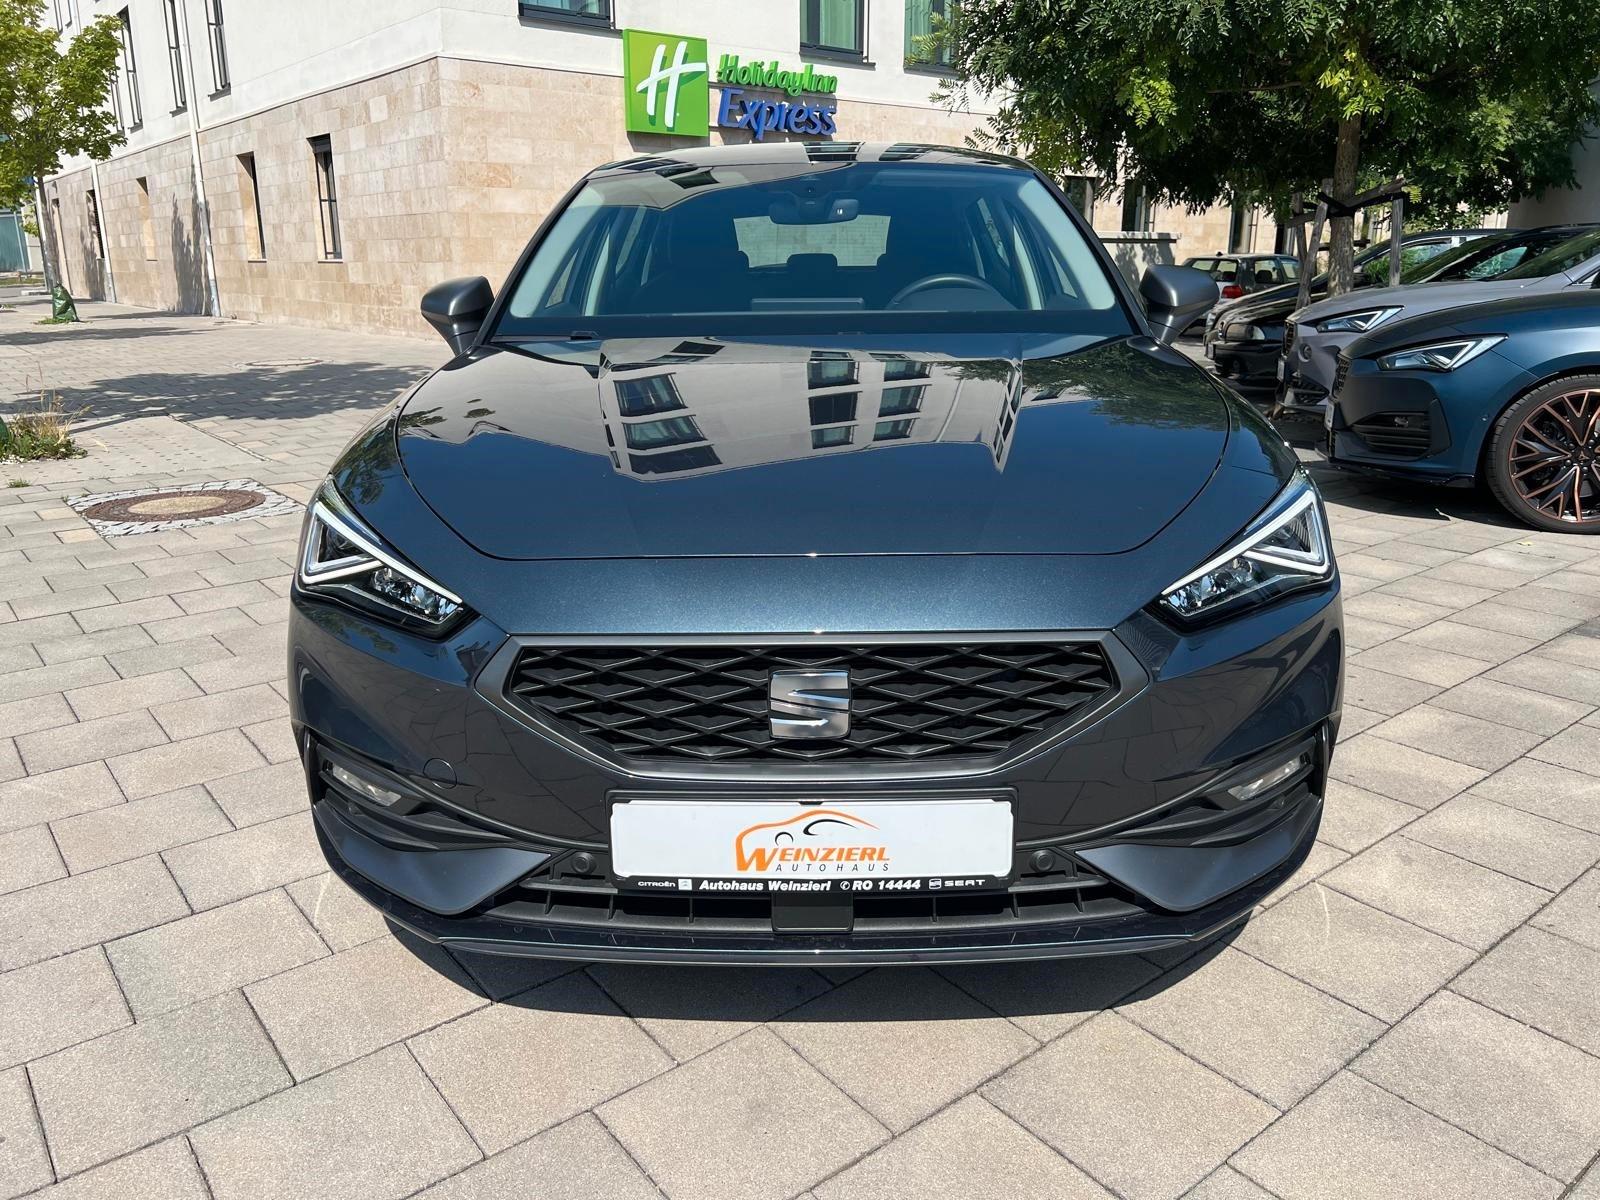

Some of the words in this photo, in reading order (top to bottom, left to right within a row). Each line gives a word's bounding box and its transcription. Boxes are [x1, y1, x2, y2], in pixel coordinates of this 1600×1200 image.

[718, 87, 837, 141] Express
[736, 847, 891, 872] WEINZIERL
[776, 863, 889, 872] AUTOHAUS
[699, 880, 764, 892] Autohaus
[768, 881, 831, 891] Weinzierl
[852, 880, 874, 891] RO
[878, 880, 921, 890] 14444
[944, 879, 986, 887] SEAT
